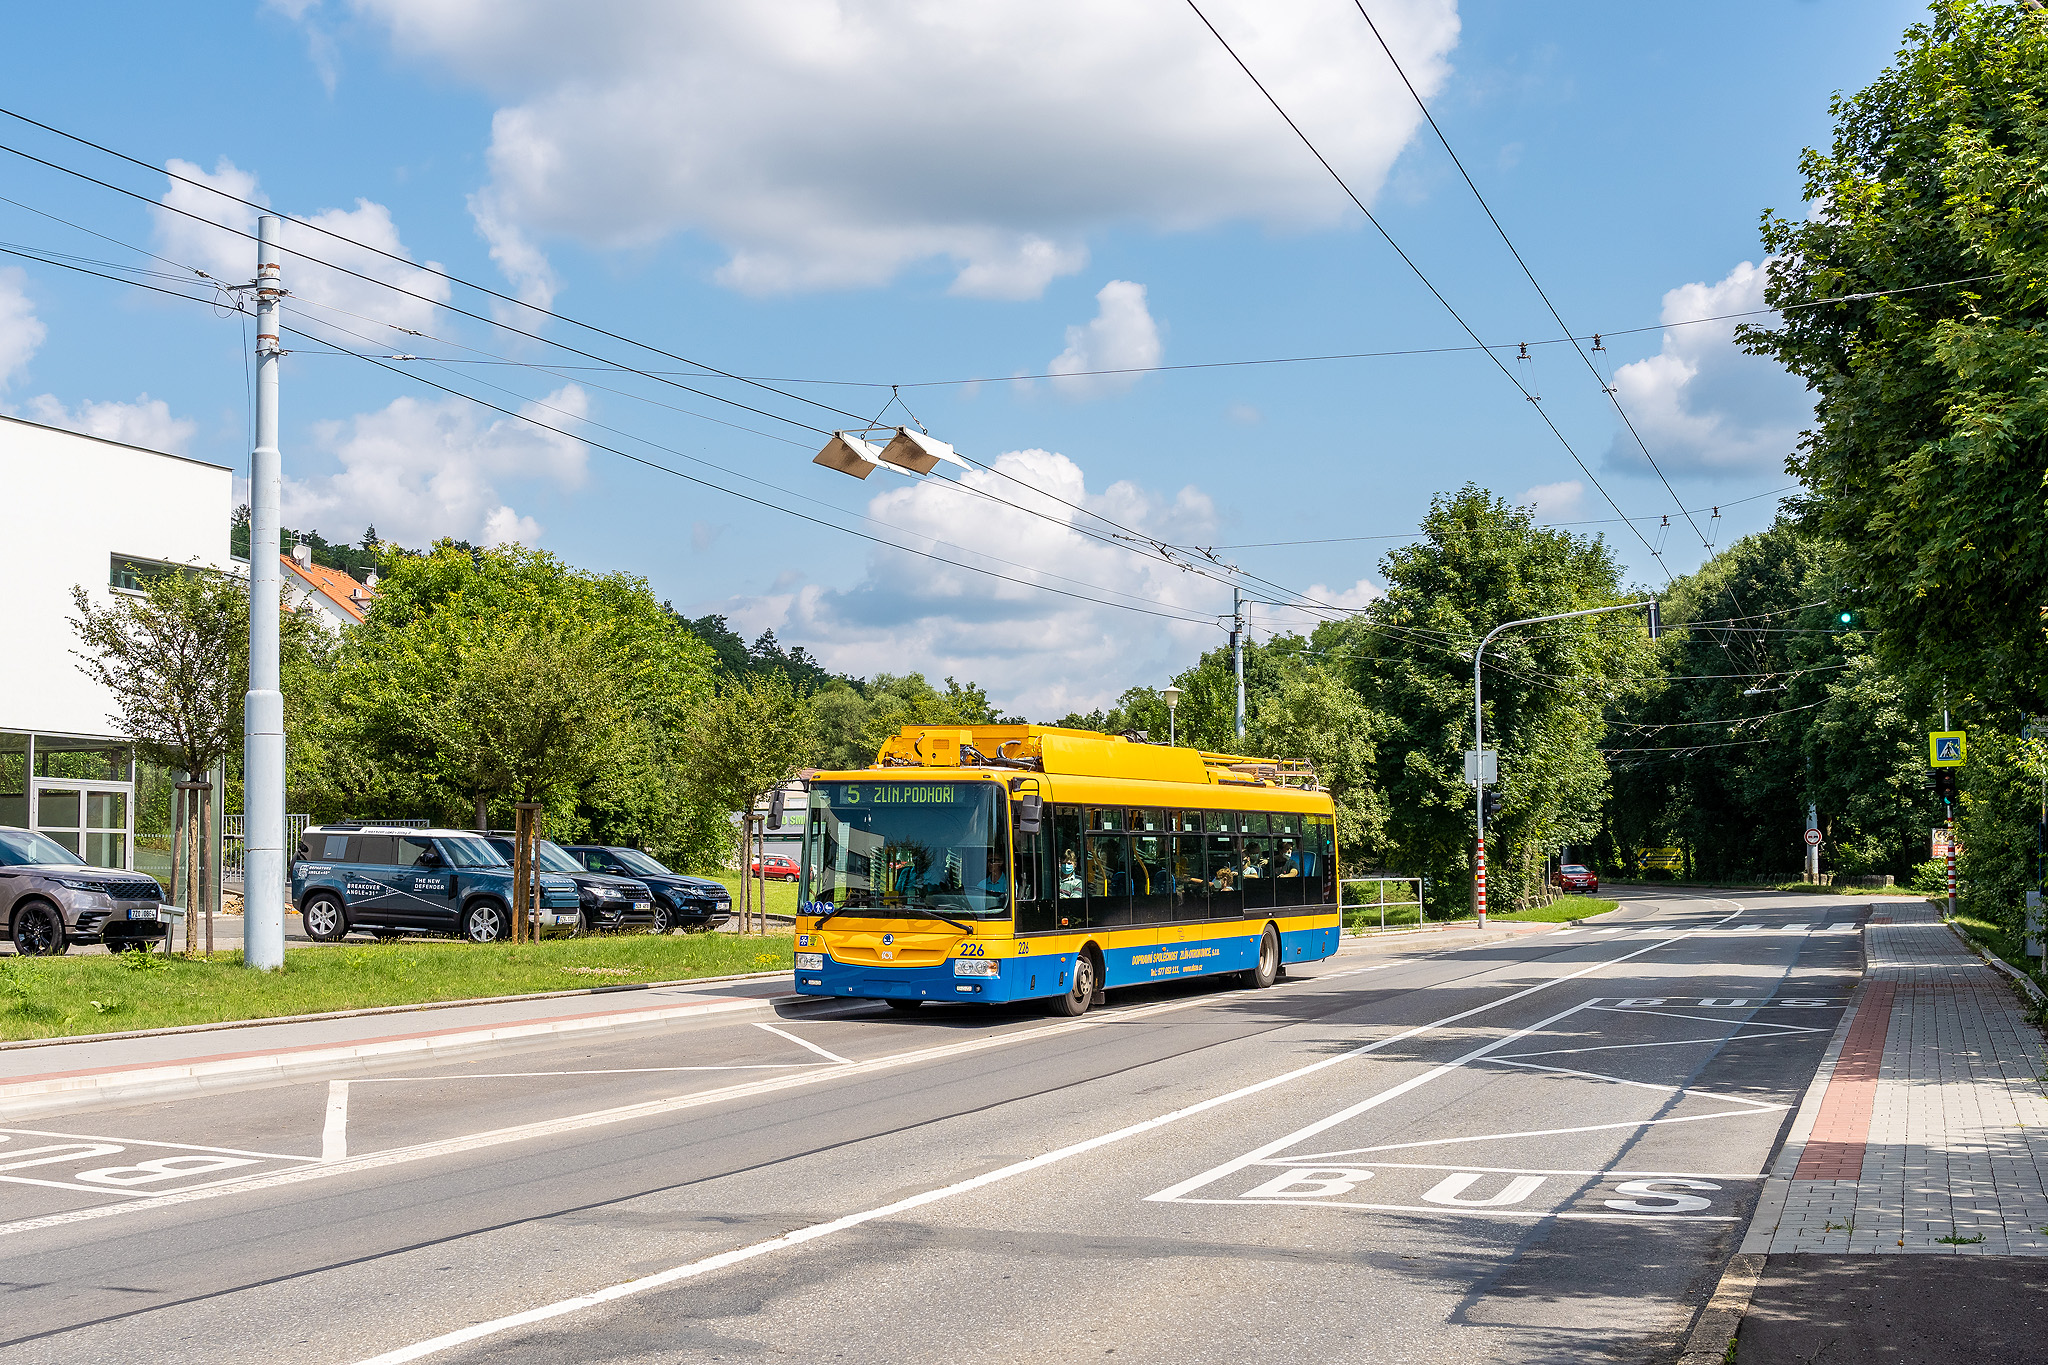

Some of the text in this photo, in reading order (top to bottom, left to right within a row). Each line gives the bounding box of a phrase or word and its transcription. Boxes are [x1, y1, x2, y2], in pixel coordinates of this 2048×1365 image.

[847, 785, 860, 803] 5
[347, 883, 381, 891] BREAKOVER
[960, 943, 985, 957] 226
[1018, 941, 1029, 954] 226
[1615, 998, 1829, 1007] BUS
[1238, 1168, 1722, 1212] BUS
